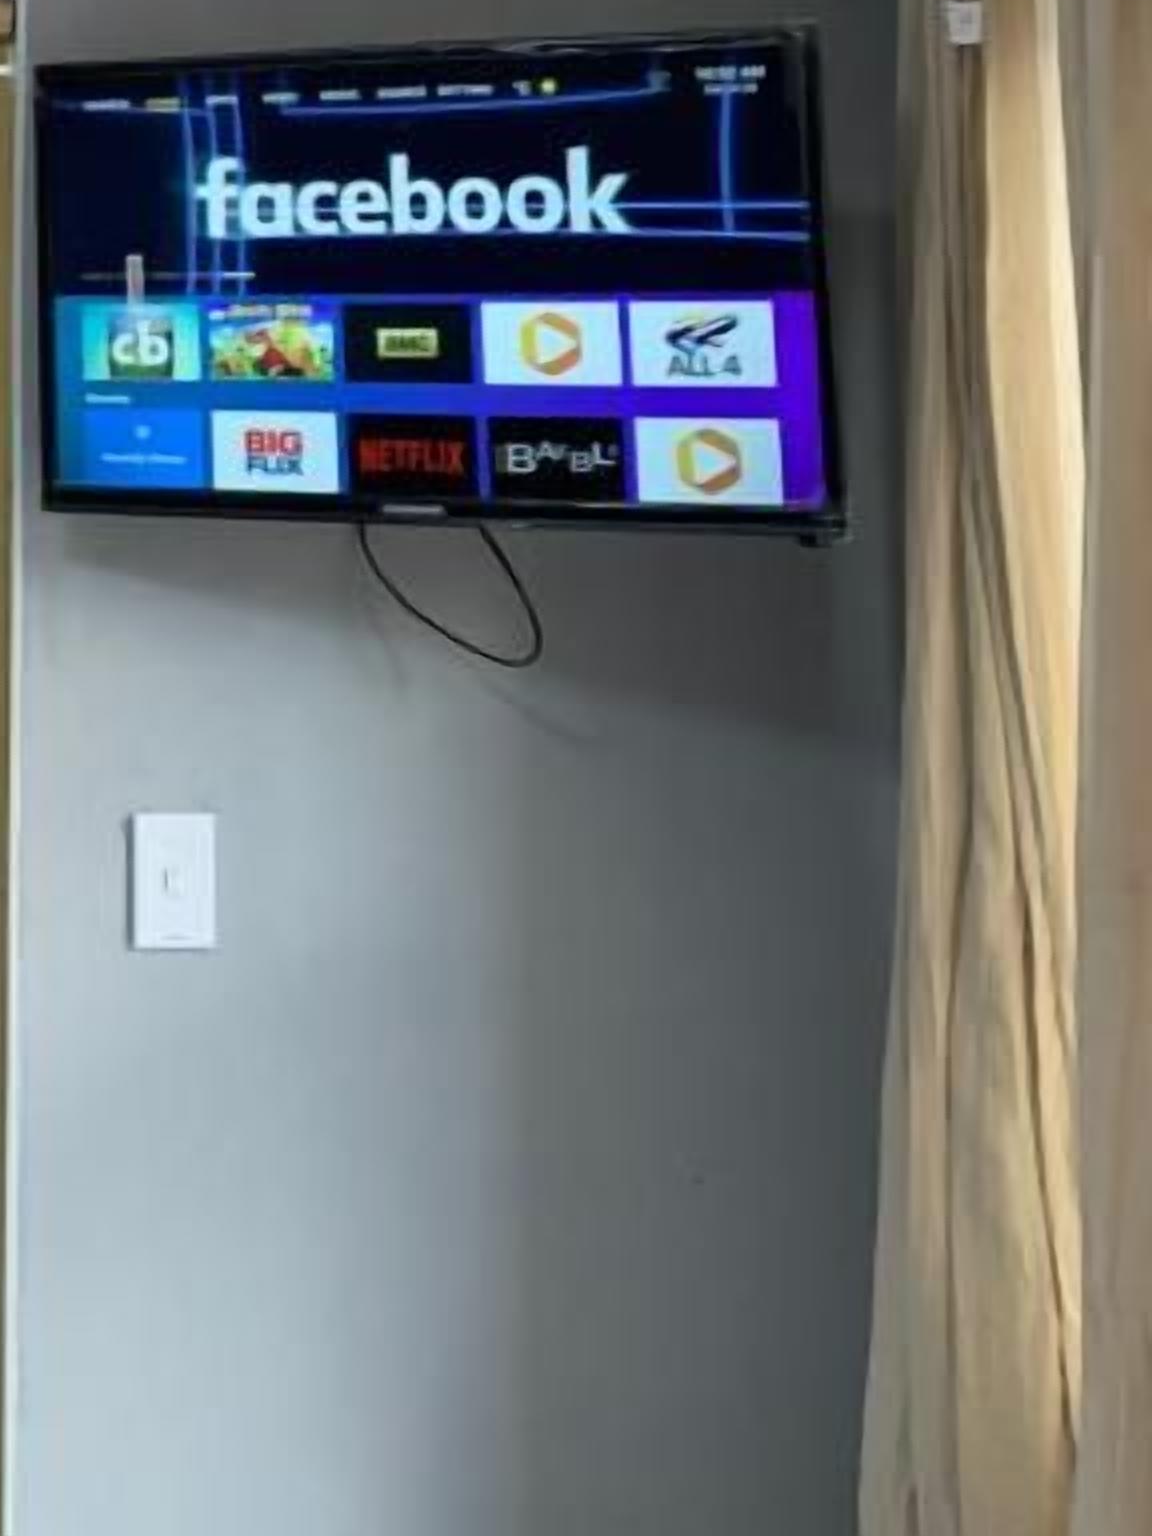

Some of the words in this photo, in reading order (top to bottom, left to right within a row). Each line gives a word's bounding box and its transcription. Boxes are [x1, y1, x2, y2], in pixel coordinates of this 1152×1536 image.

[195, 145, 634, 240] facebook
[666, 353, 717, 378] ALL
[244, 430, 304, 456] BIG
[358, 438, 466, 475] NETFLIX
